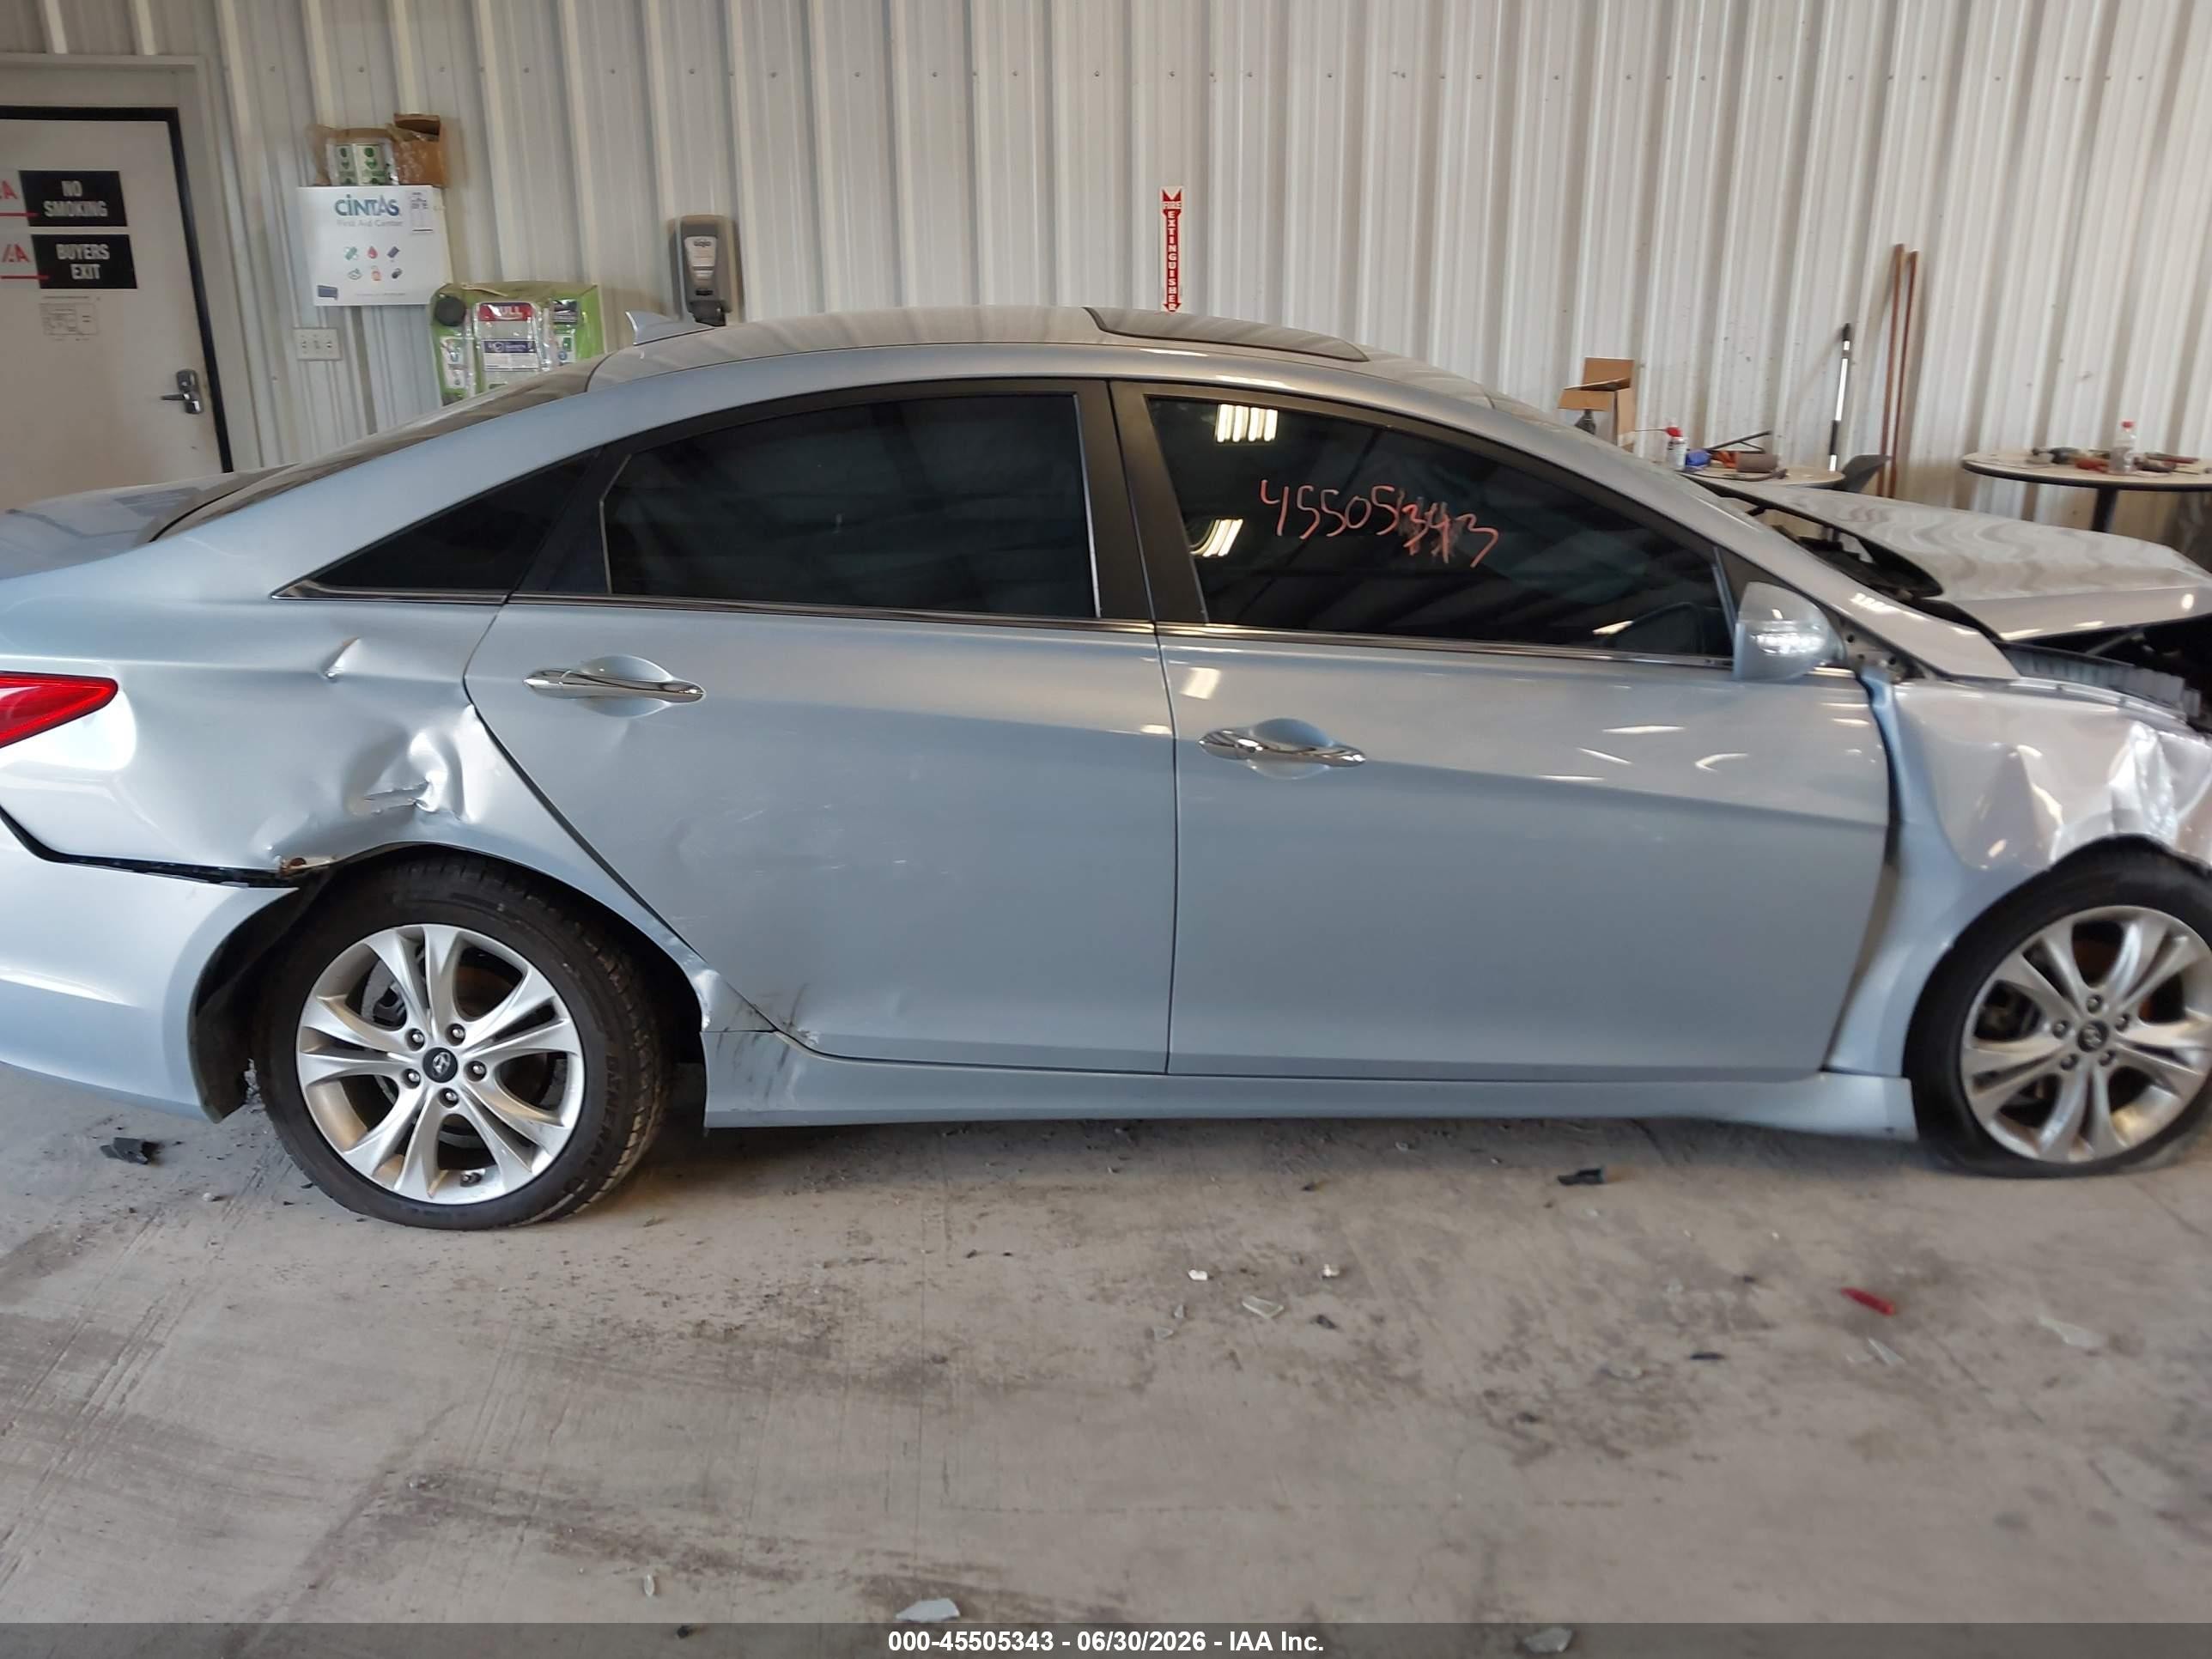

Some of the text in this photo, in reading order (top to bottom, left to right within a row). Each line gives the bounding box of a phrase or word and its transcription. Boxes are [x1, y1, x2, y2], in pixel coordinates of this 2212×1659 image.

[62, 180, 82, 197] NO
[44, 200, 108, 217] SMOKING
[55, 244, 110, 260] BUYERS
[1168, 210, 1177, 311] EXTINGUISHER
[70, 264, 101, 279] EXIT
